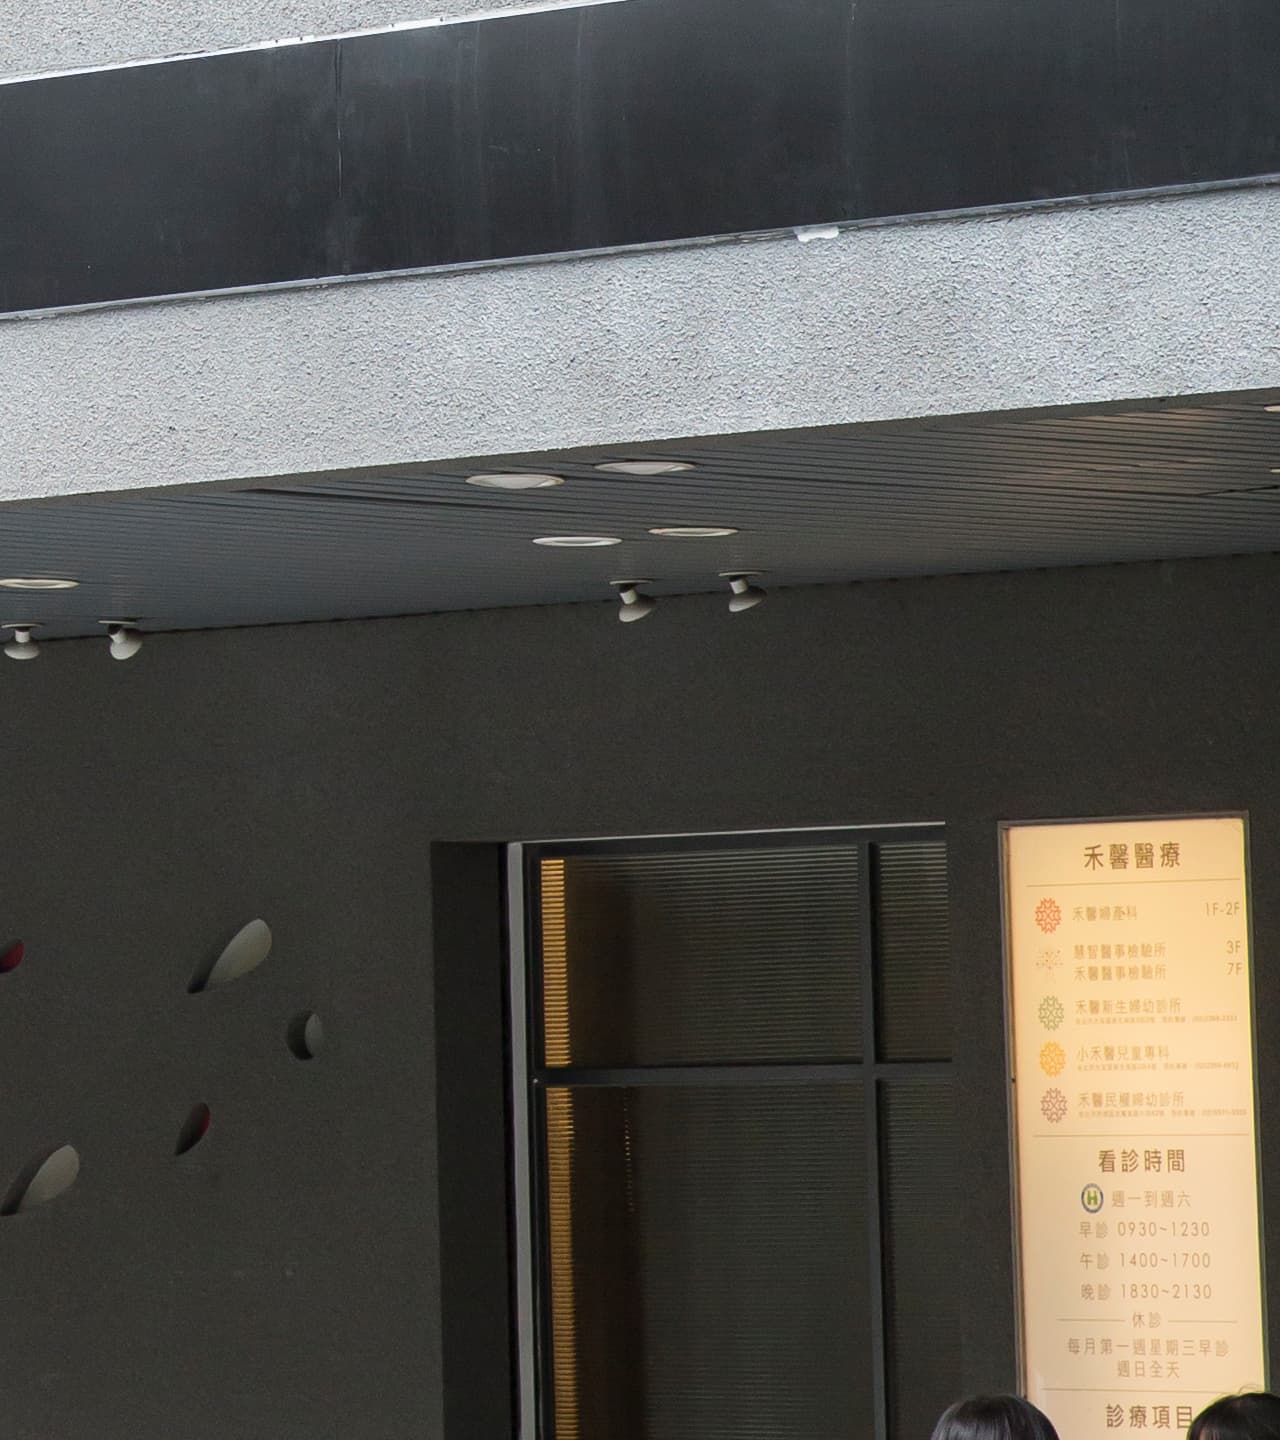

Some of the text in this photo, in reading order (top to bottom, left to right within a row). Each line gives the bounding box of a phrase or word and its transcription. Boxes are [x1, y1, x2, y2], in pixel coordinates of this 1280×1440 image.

[1205, 902, 1240, 917] 1F-2F
[1227, 940, 1240, 954] 3F
[1227, 962, 1242, 976] 7F
[1098, 1149, 1185, 1173] 看診時間
[1117, 1222, 1210, 1237] 0930~1230
[1120, 1252, 1211, 1268] 1400~1700
[1122, 1284, 1212, 1299] 1830~2130
